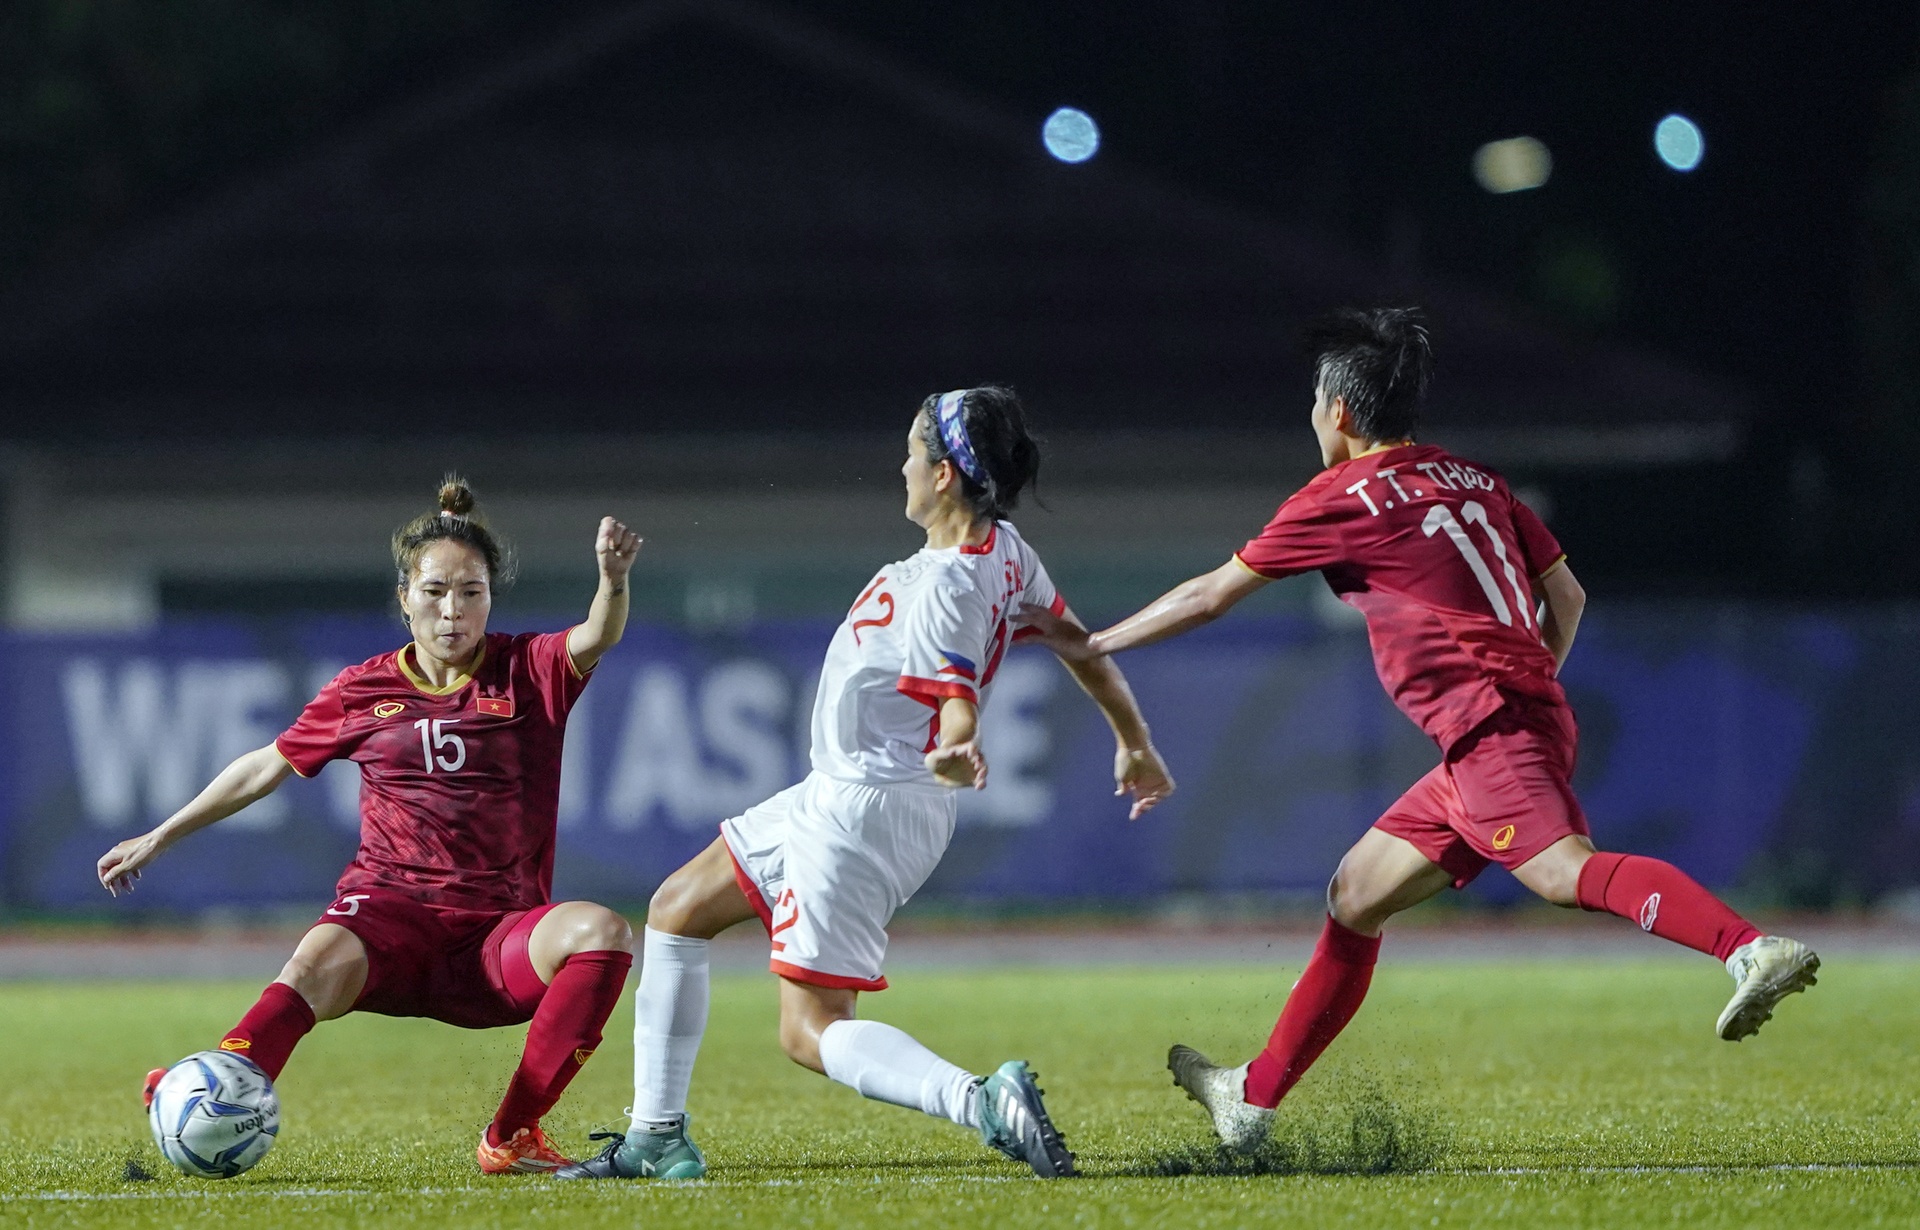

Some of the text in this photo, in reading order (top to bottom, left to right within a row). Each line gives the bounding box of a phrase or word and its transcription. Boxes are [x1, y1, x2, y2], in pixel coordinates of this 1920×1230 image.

[1421, 500, 1531, 629] 11
[849, 576, 895, 647] 12
[62, 656, 287, 829] WE
[601, 658, 788, 831] AS
[413, 718, 466, 774] 15
[319, 894, 370, 920] 5
[771, 889, 799, 953] 2
